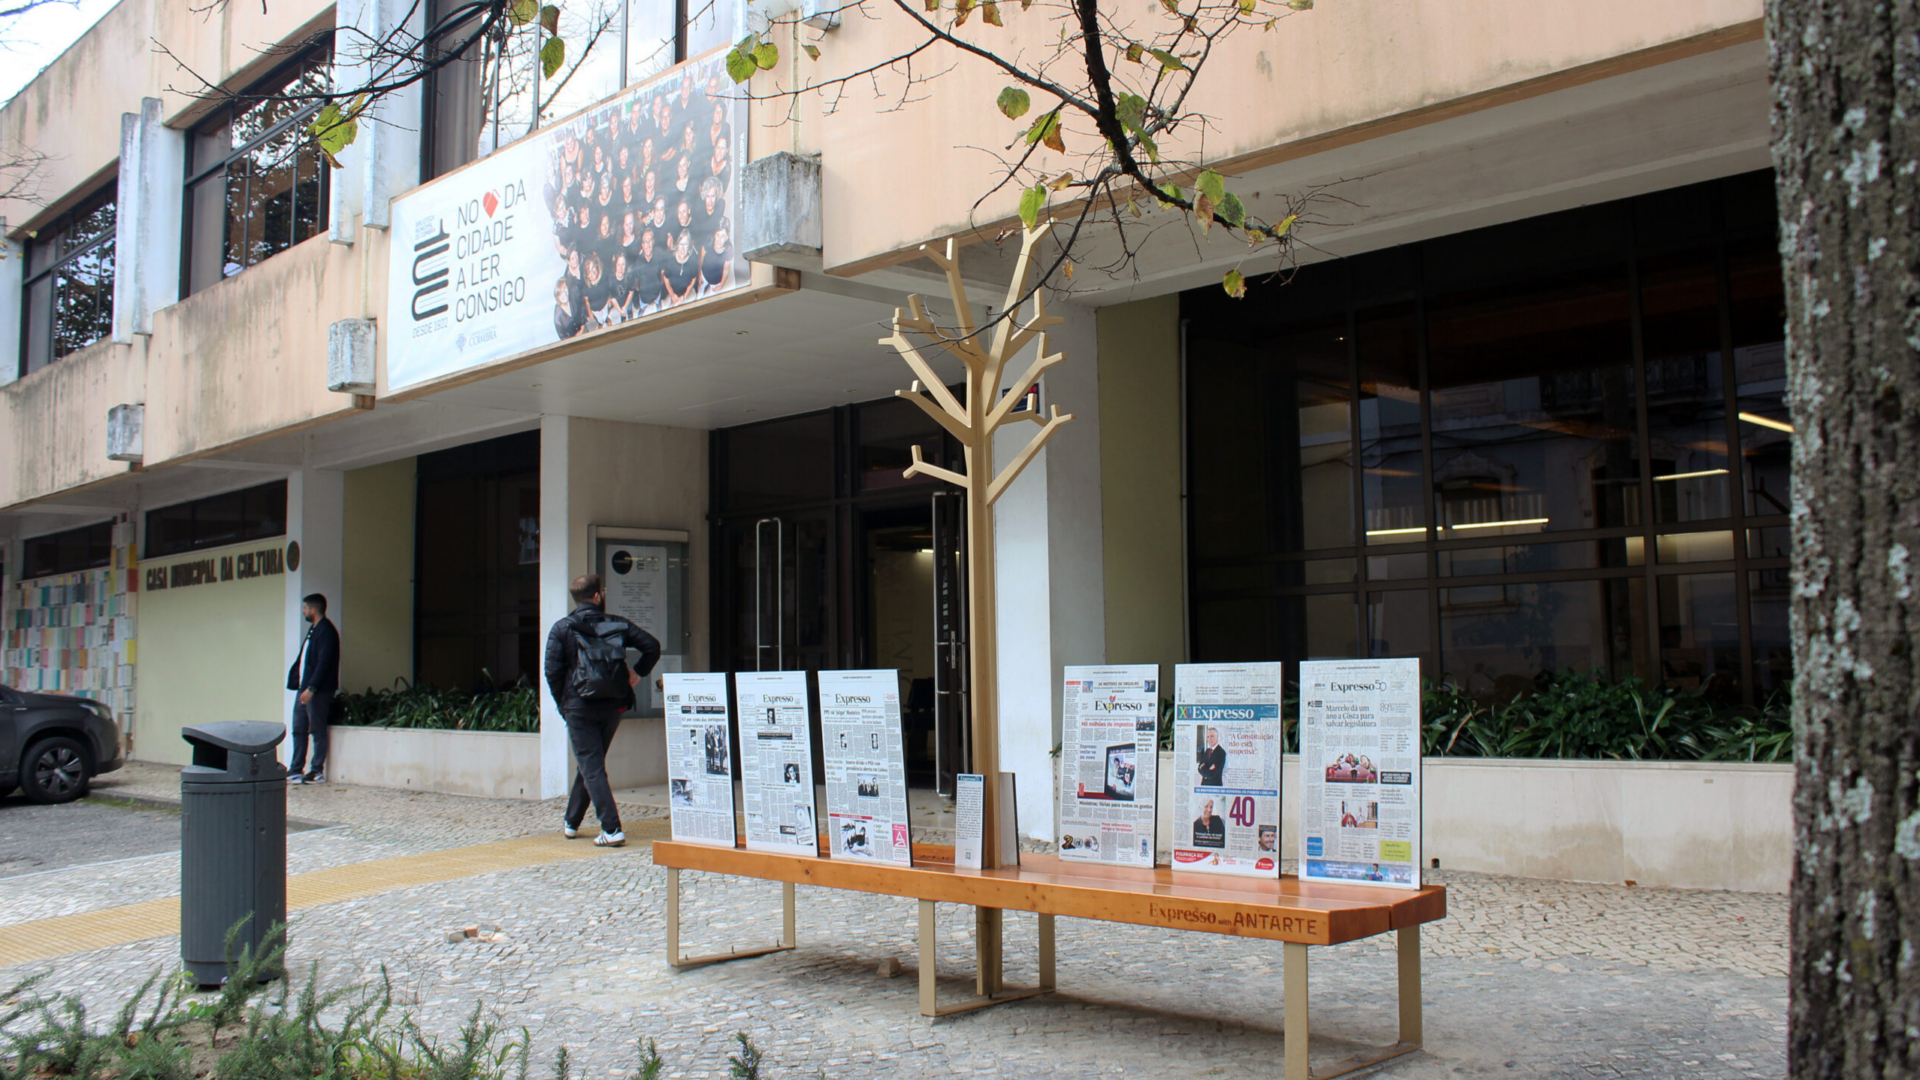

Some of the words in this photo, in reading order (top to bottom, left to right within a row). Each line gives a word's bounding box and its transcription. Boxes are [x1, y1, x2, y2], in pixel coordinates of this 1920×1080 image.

[457, 199, 479, 230] NO
[504, 178, 526, 209] DA
[457, 214, 514, 260] CIDADE
[456, 266, 466, 292] A
[471, 253, 500, 287] LER
[456, 276, 525, 323] CONSIGO
[412, 322, 433, 339] DESDE
[434, 317, 448, 331] 1922
[468, 330, 498, 347] COIMBRA
[146, 566, 168, 591] CASA
[170, 558, 217, 588] MUNICIPAL
[220, 556, 233, 582] DA
[237, 548, 284, 579] CULTURA
[1331, 682, 1375, 693] Expresso
[688, 693, 717, 704] Expresso
[763, 694, 793, 704] Expresso
[835, 693, 871, 705] Expresso
[1095, 700, 1142, 713] Expresso
[1192, 705, 1255, 721] Expresso
[1344, 720, 1377, 728] legislatura
[1237, 732, 1273, 740] Constituição
[1229, 796, 1255, 827] 40
[1149, 902, 1216, 924] Expresso
[1218, 918, 1232, 926] with
[1233, 911, 1317, 936] ANTARTE
